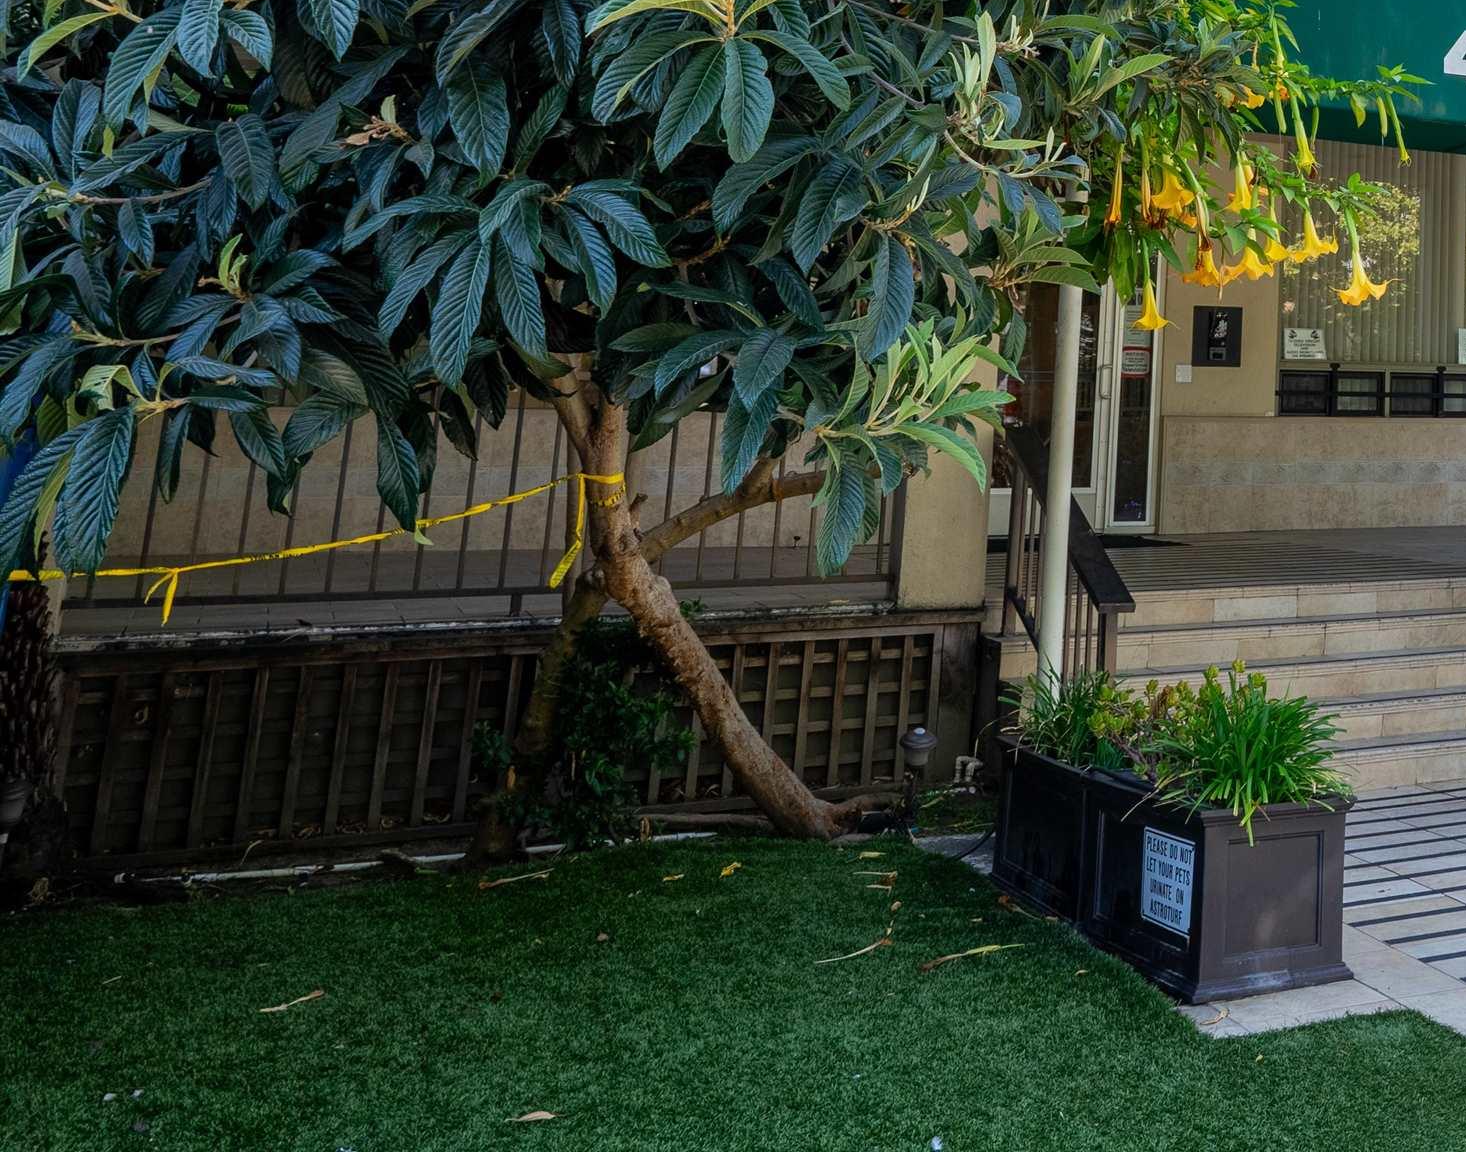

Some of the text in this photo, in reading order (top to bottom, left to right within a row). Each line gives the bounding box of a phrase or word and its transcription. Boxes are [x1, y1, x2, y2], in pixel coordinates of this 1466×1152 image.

[1146, 835, 1193, 865] PLEASE DO NOT
[1146, 855, 1190, 885] LET YOUR PETS
[1150, 878, 1184, 905] URINATE ON
[1150, 898, 1182, 925] ASTROTURF
